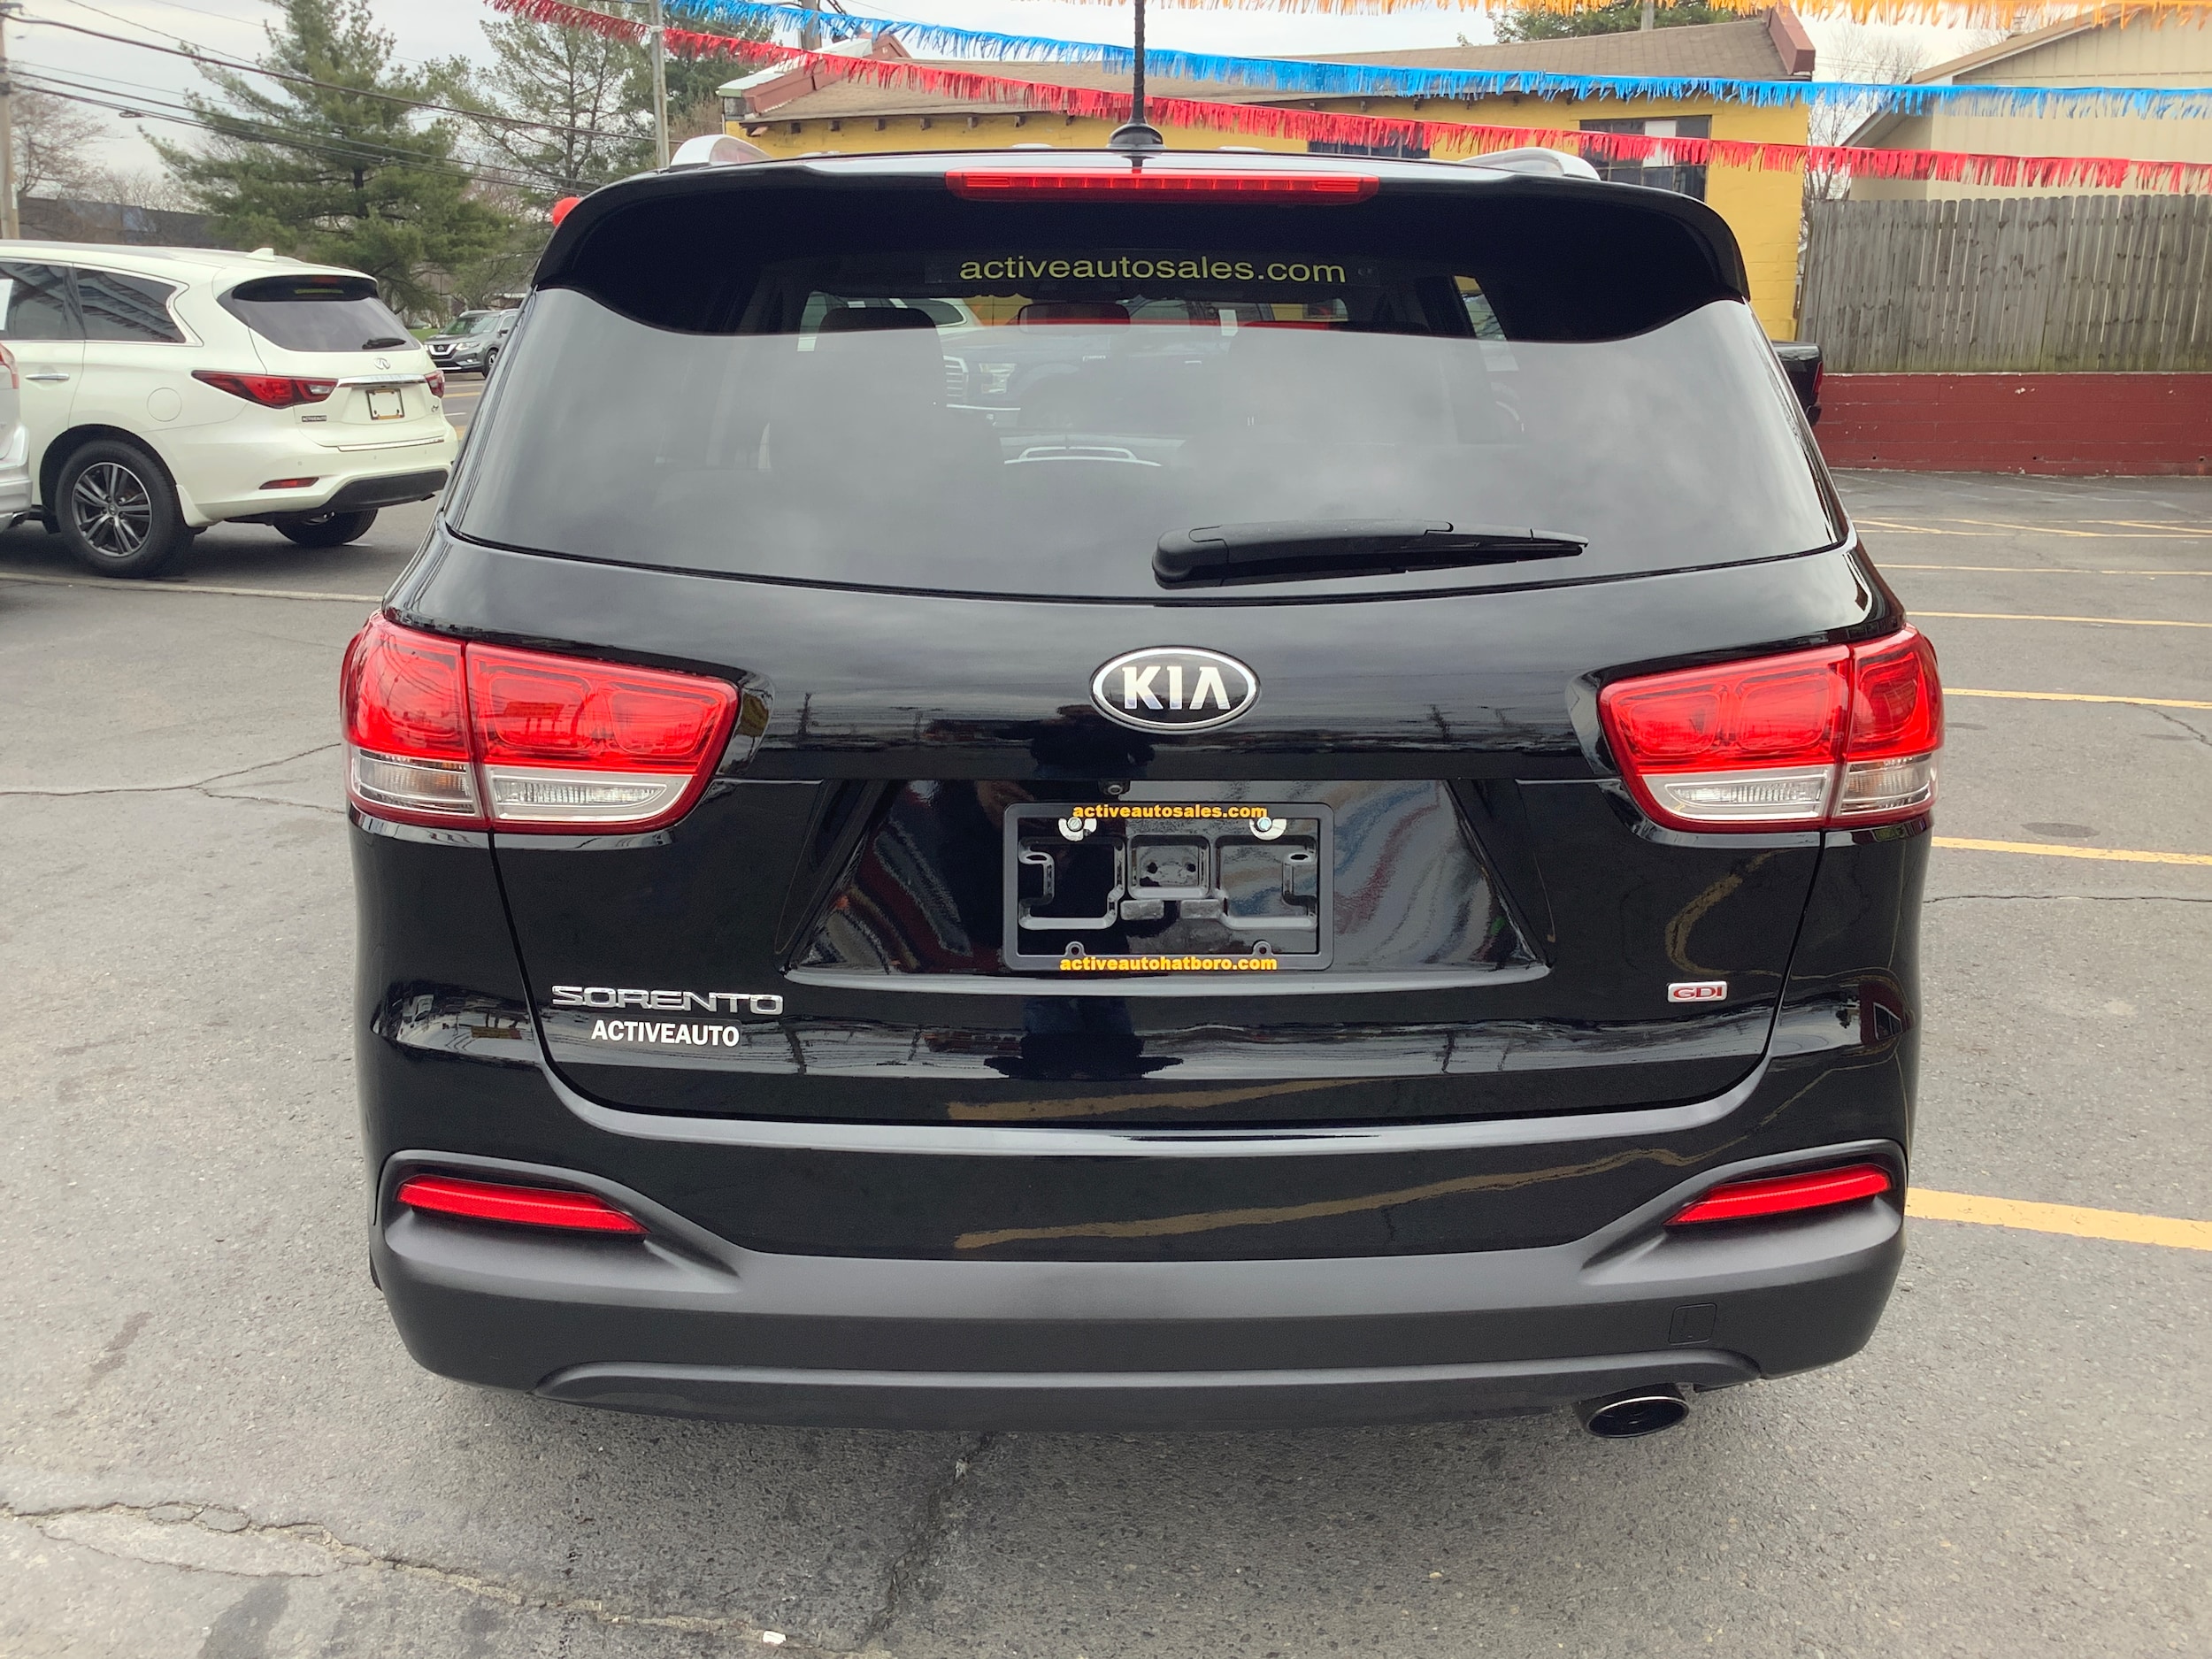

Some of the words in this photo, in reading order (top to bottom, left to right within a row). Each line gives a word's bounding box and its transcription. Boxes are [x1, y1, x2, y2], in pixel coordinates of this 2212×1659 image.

[959, 256, 1347, 283] activeautosales.com
[1122, 665, 1231, 710] KIA
[1072, 804, 1268, 818] activeautosales.com
[1060, 956, 1278, 971] activeautohatboro.com
[552, 985, 783, 1015] SORENTO
[1673, 986, 1723, 999] GDI
[591, 1019, 740, 1048] ACTIVEAUTO
